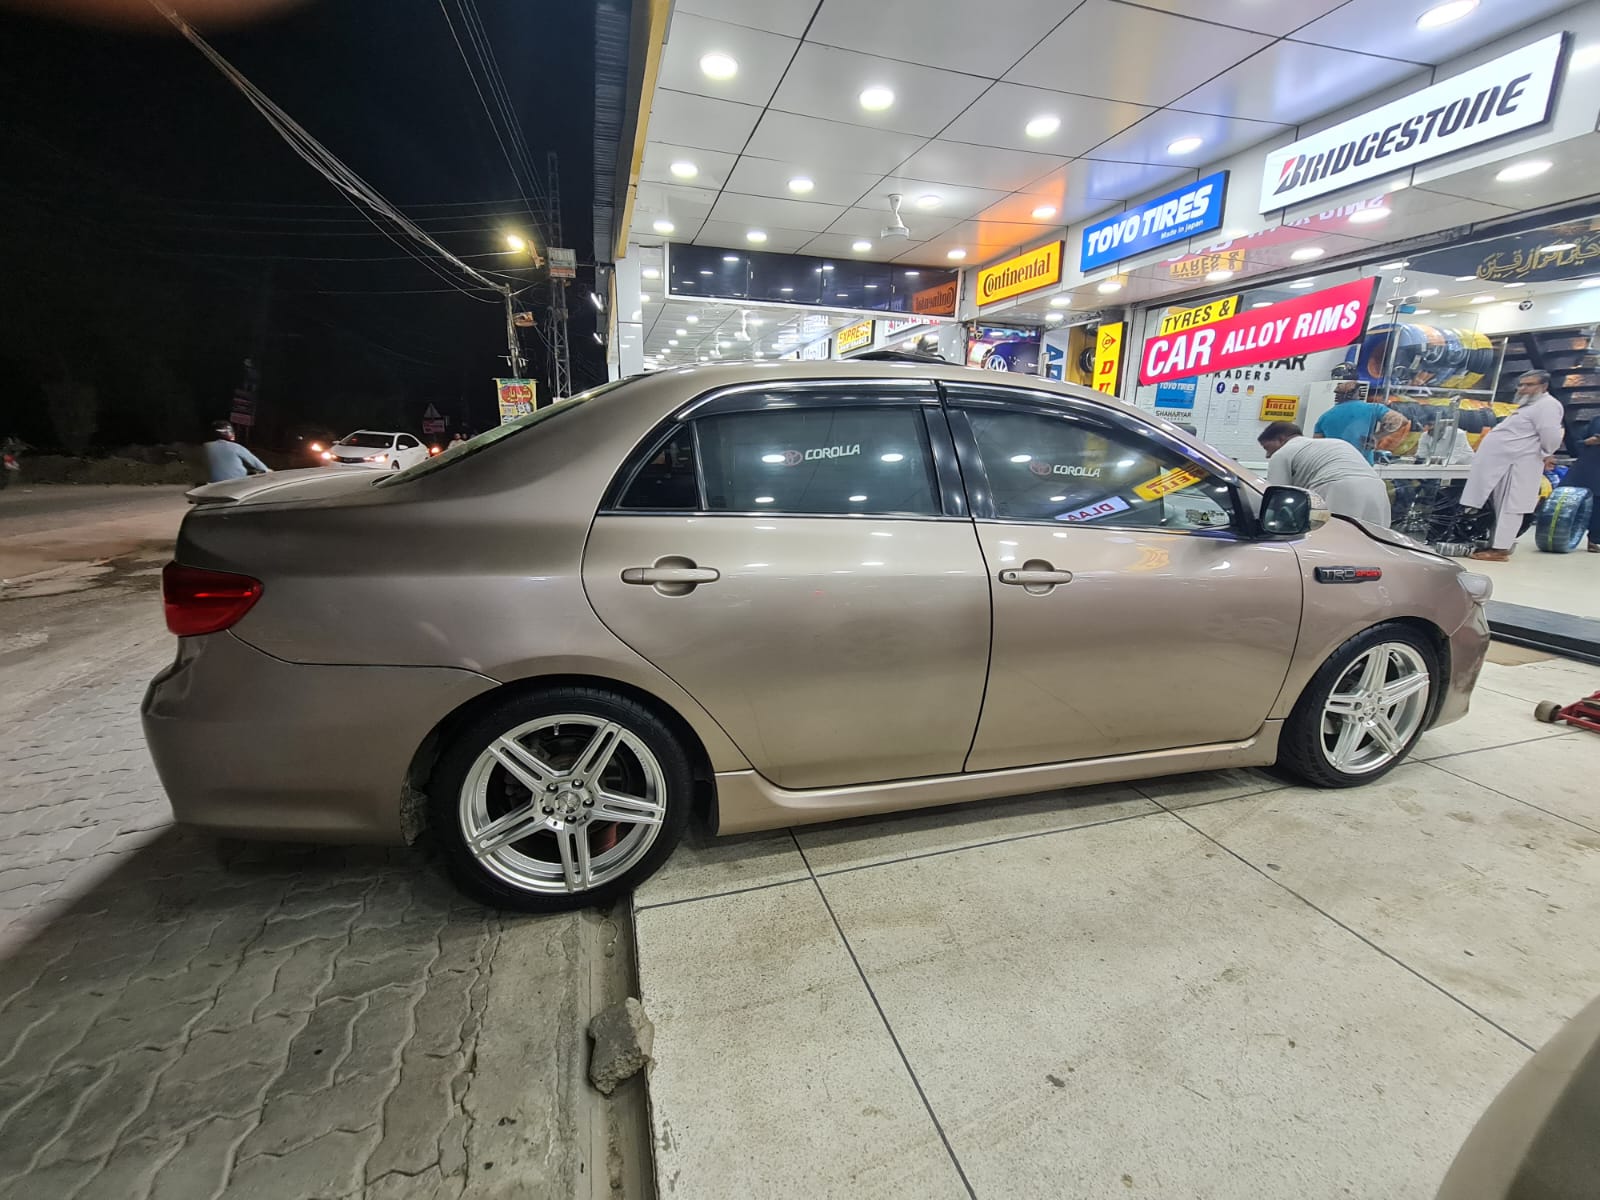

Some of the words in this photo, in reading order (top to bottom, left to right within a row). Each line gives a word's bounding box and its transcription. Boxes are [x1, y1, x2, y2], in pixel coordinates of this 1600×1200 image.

[1273, 73, 1534, 195] BRIDGESTONE
[1087, 213, 1141, 256] TOYO
[1142, 184, 1213, 240] TIRES
[983, 252, 1051, 297] Continental
[1163, 309, 1212, 333] TYRES
[1218, 303, 1231, 317] &
[1146, 328, 1216, 378] CAR
[1220, 317, 1294, 355] ALLOY
[1292, 300, 1361, 339] RIMS
[805, 444, 861, 460] COROLLA
[1053, 465, 1100, 478] COROLLA
[1322, 569, 1355, 582] TRD
